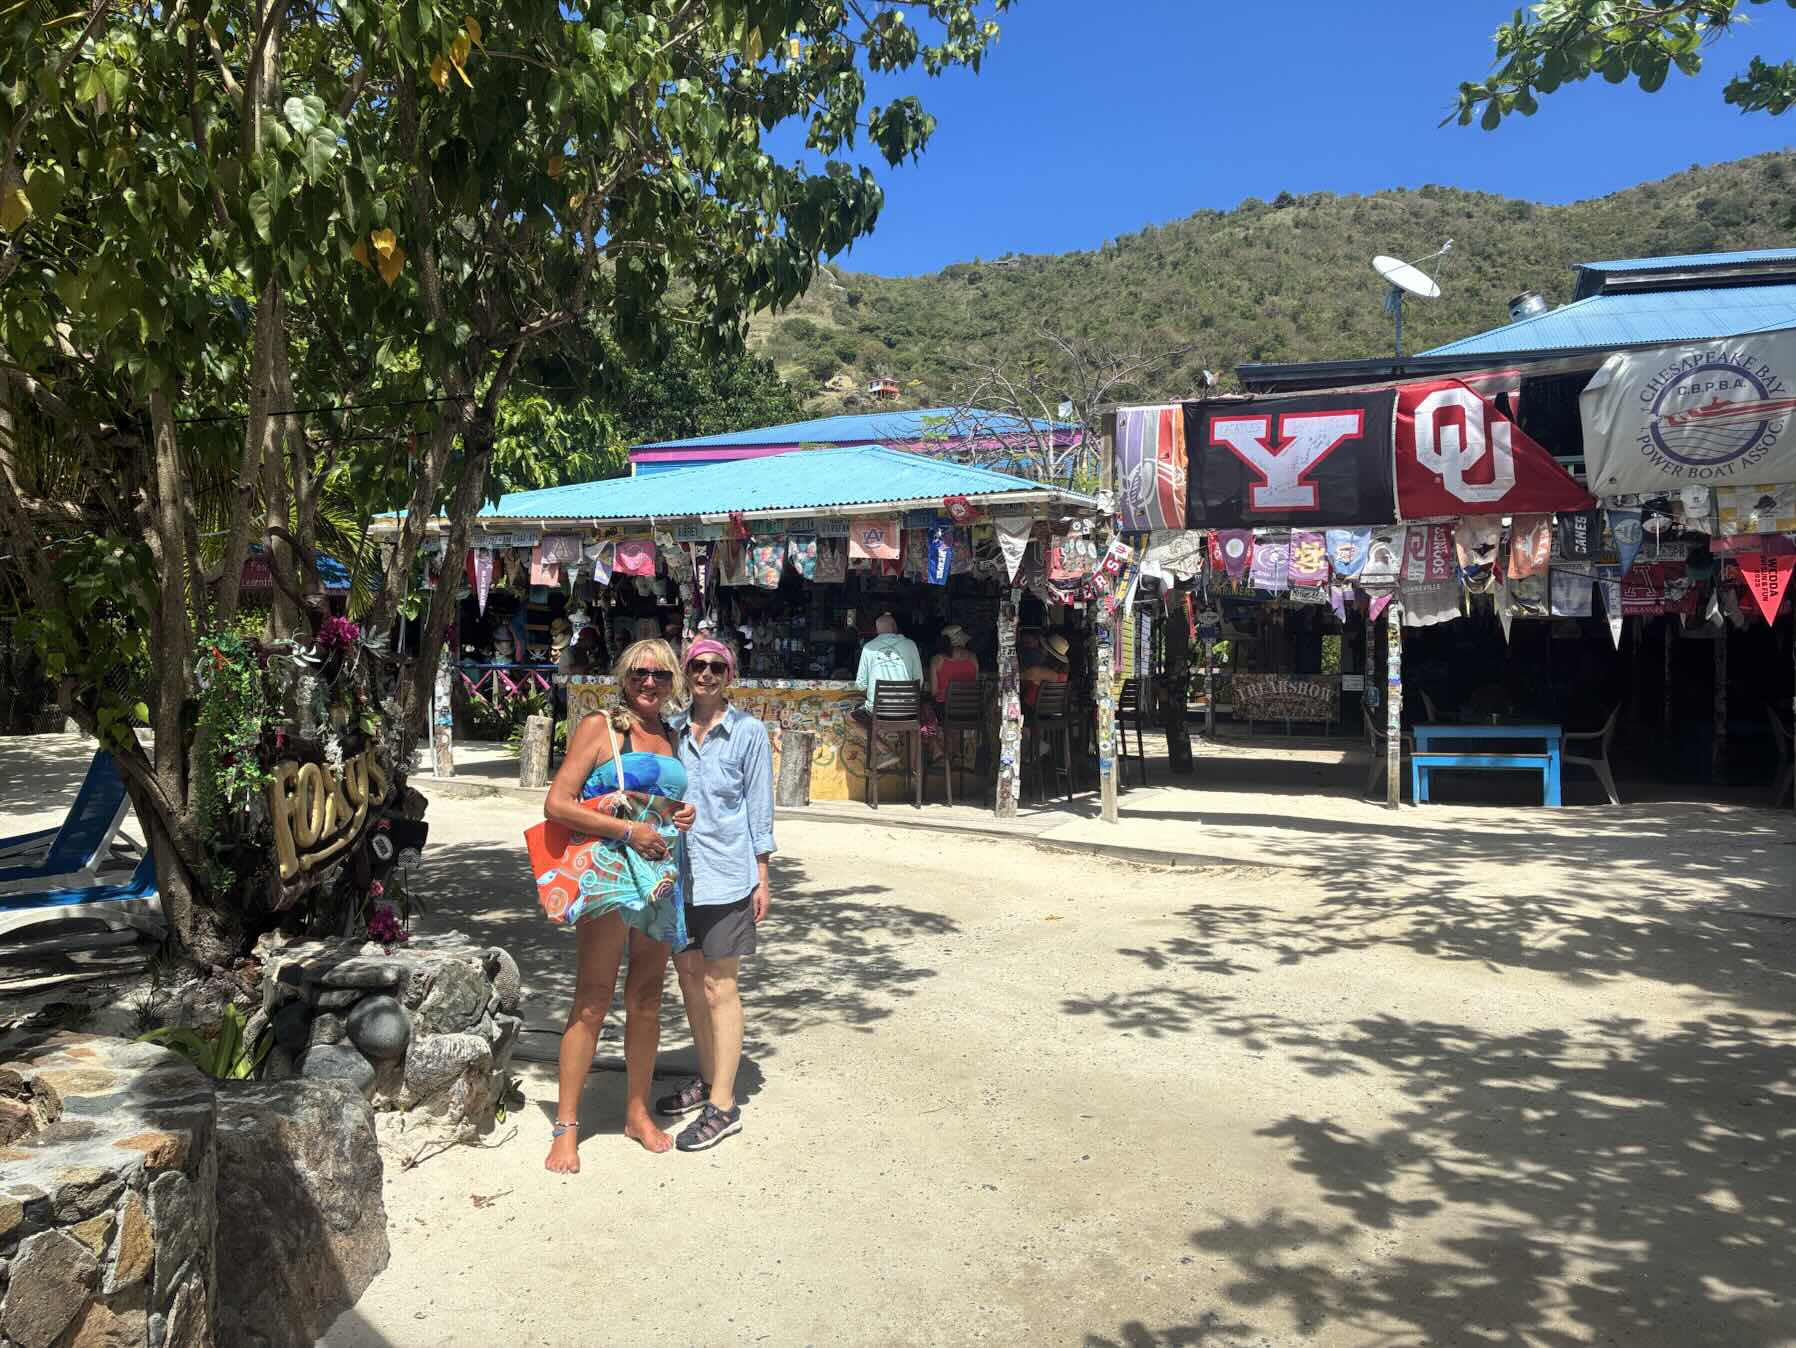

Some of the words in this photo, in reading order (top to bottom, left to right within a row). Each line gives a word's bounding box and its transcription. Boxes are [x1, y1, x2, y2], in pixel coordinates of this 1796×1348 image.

[1640, 351, 1757, 403] CHESAPEAKE
[1756, 366, 1786, 395] BAY
[1678, 379, 1746, 396] C.B.P.B.A.
[1209, 408, 1365, 513] Y
[1414, 387, 1515, 503] OU
[1636, 435, 1685, 478] POWER
[1687, 463, 1736, 480] BOAT
[1574, 515, 1587, 554] CANES
[698, 564, 706, 594] NAVY
